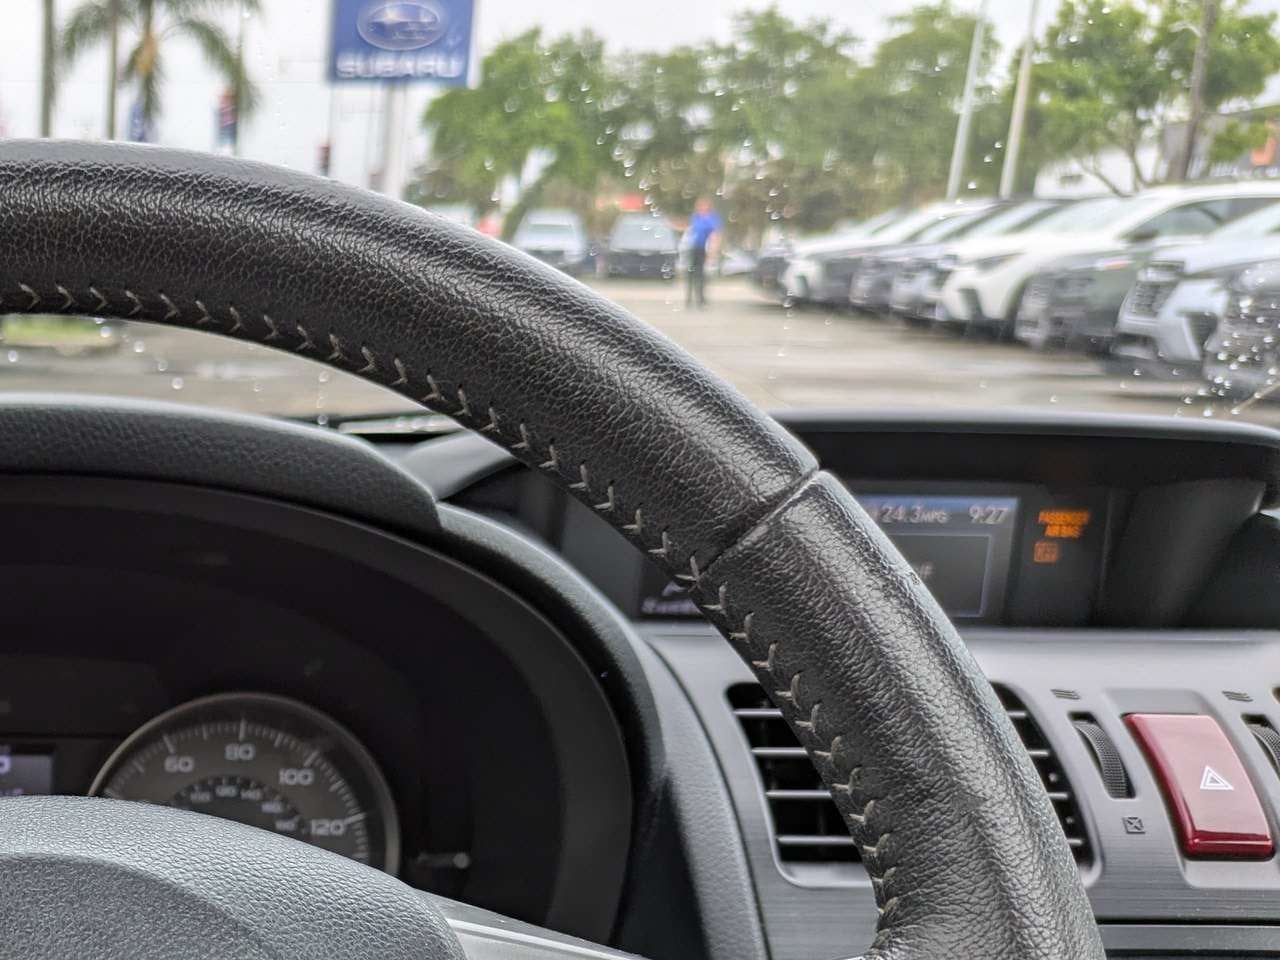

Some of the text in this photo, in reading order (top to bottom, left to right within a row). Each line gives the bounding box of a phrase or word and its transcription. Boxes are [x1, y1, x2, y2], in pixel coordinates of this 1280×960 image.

[969, 505, 1009, 525] 9:27
[224, 743, 255, 760] 80
[164, 756, 195, 773] 60
[278, 768, 315, 786] 100
[310, 818, 346, 836] 120
